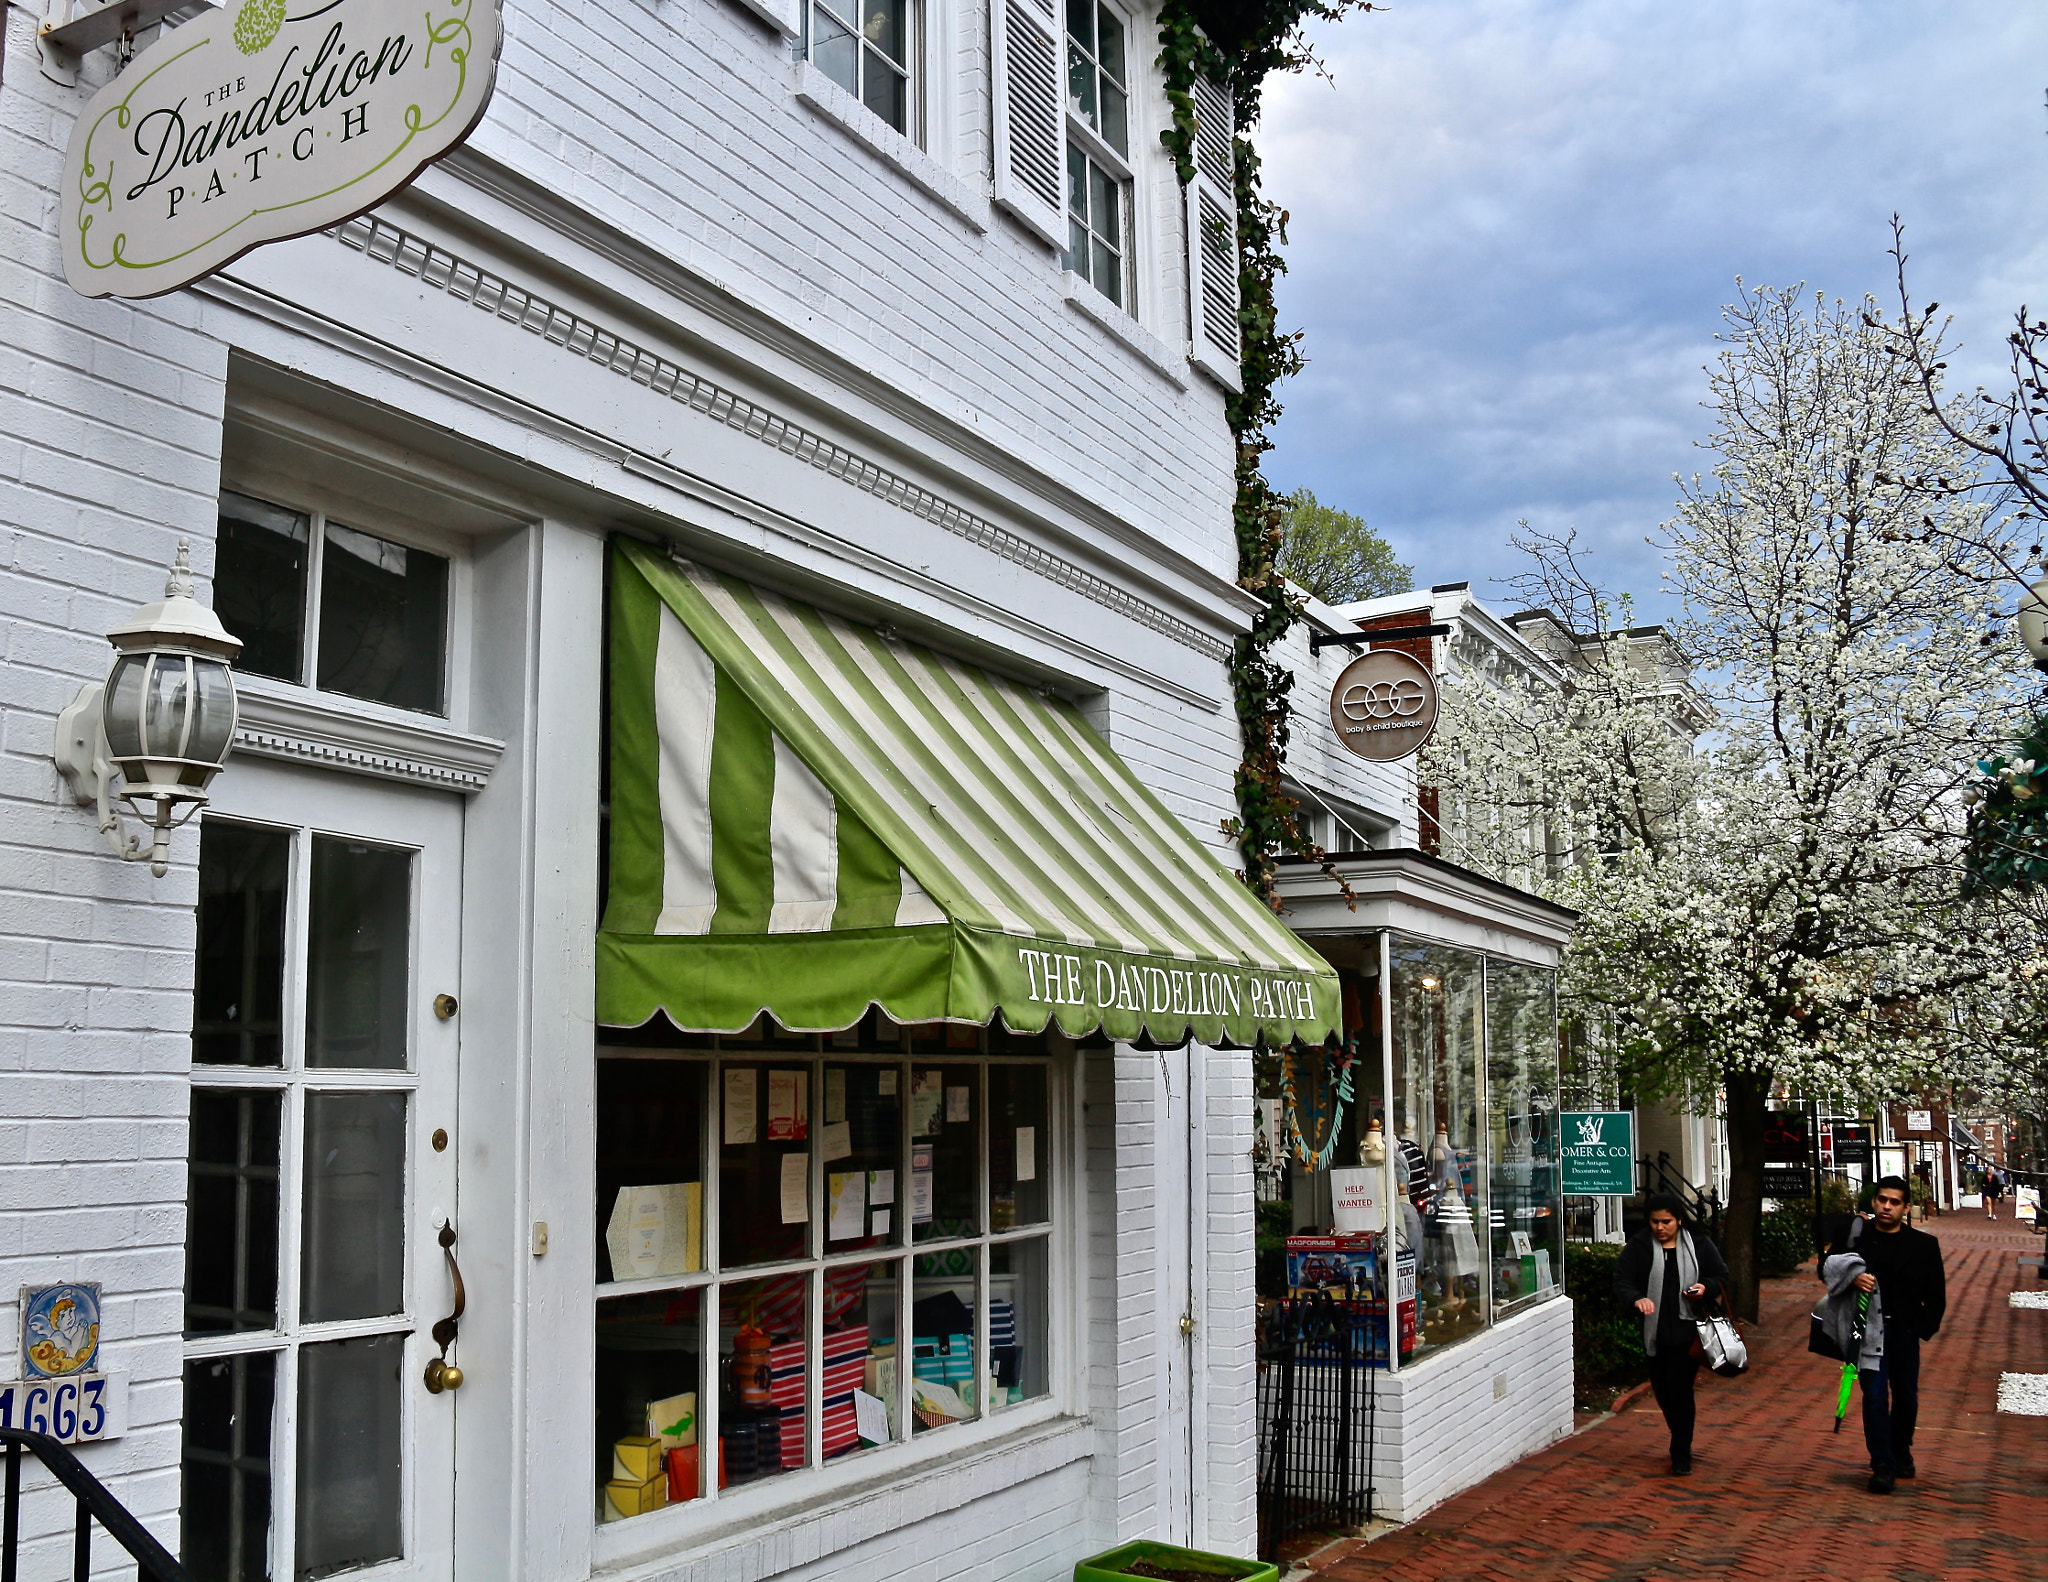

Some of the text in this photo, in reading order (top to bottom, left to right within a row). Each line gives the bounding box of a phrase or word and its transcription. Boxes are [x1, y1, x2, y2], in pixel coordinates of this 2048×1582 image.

[204, 76, 246, 107] THE
[127, 21, 415, 200] Dandelion
[1345, 720, 1424, 734] baby & child boutique
[1018, 948, 1316, 1020] THE DANDELION PATCH
[1561, 1146, 1630, 1157] OMER & CO.
[1344, 1185, 1364, 1193] HELP
[1337, 1199, 1373, 1208] WANTED
[0, 1380, 106, 1445] 1663
